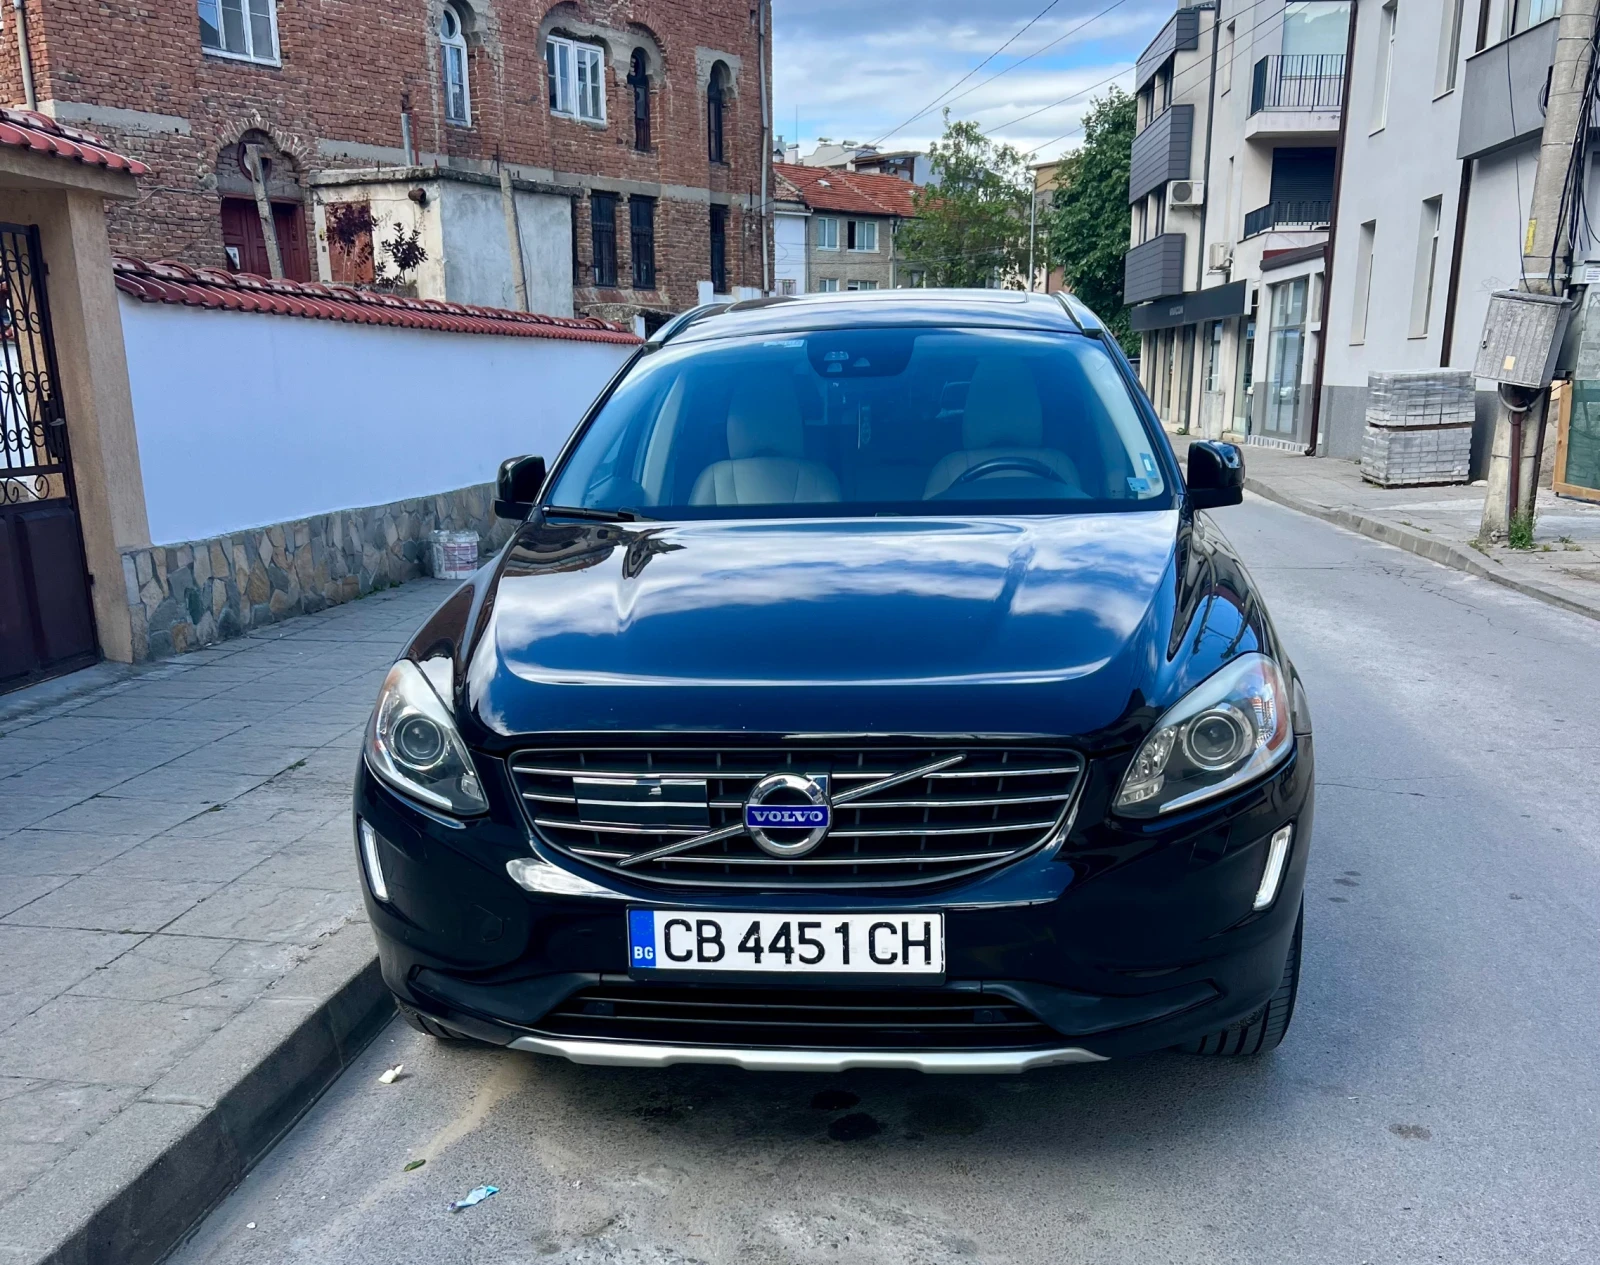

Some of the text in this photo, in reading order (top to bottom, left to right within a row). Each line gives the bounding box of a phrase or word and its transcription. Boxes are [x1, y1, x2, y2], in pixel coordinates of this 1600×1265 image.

[752, 811, 823, 822] VOLVO
[664, 918, 932, 965] CB 4451 CH
[633, 946, 654, 959] BG
